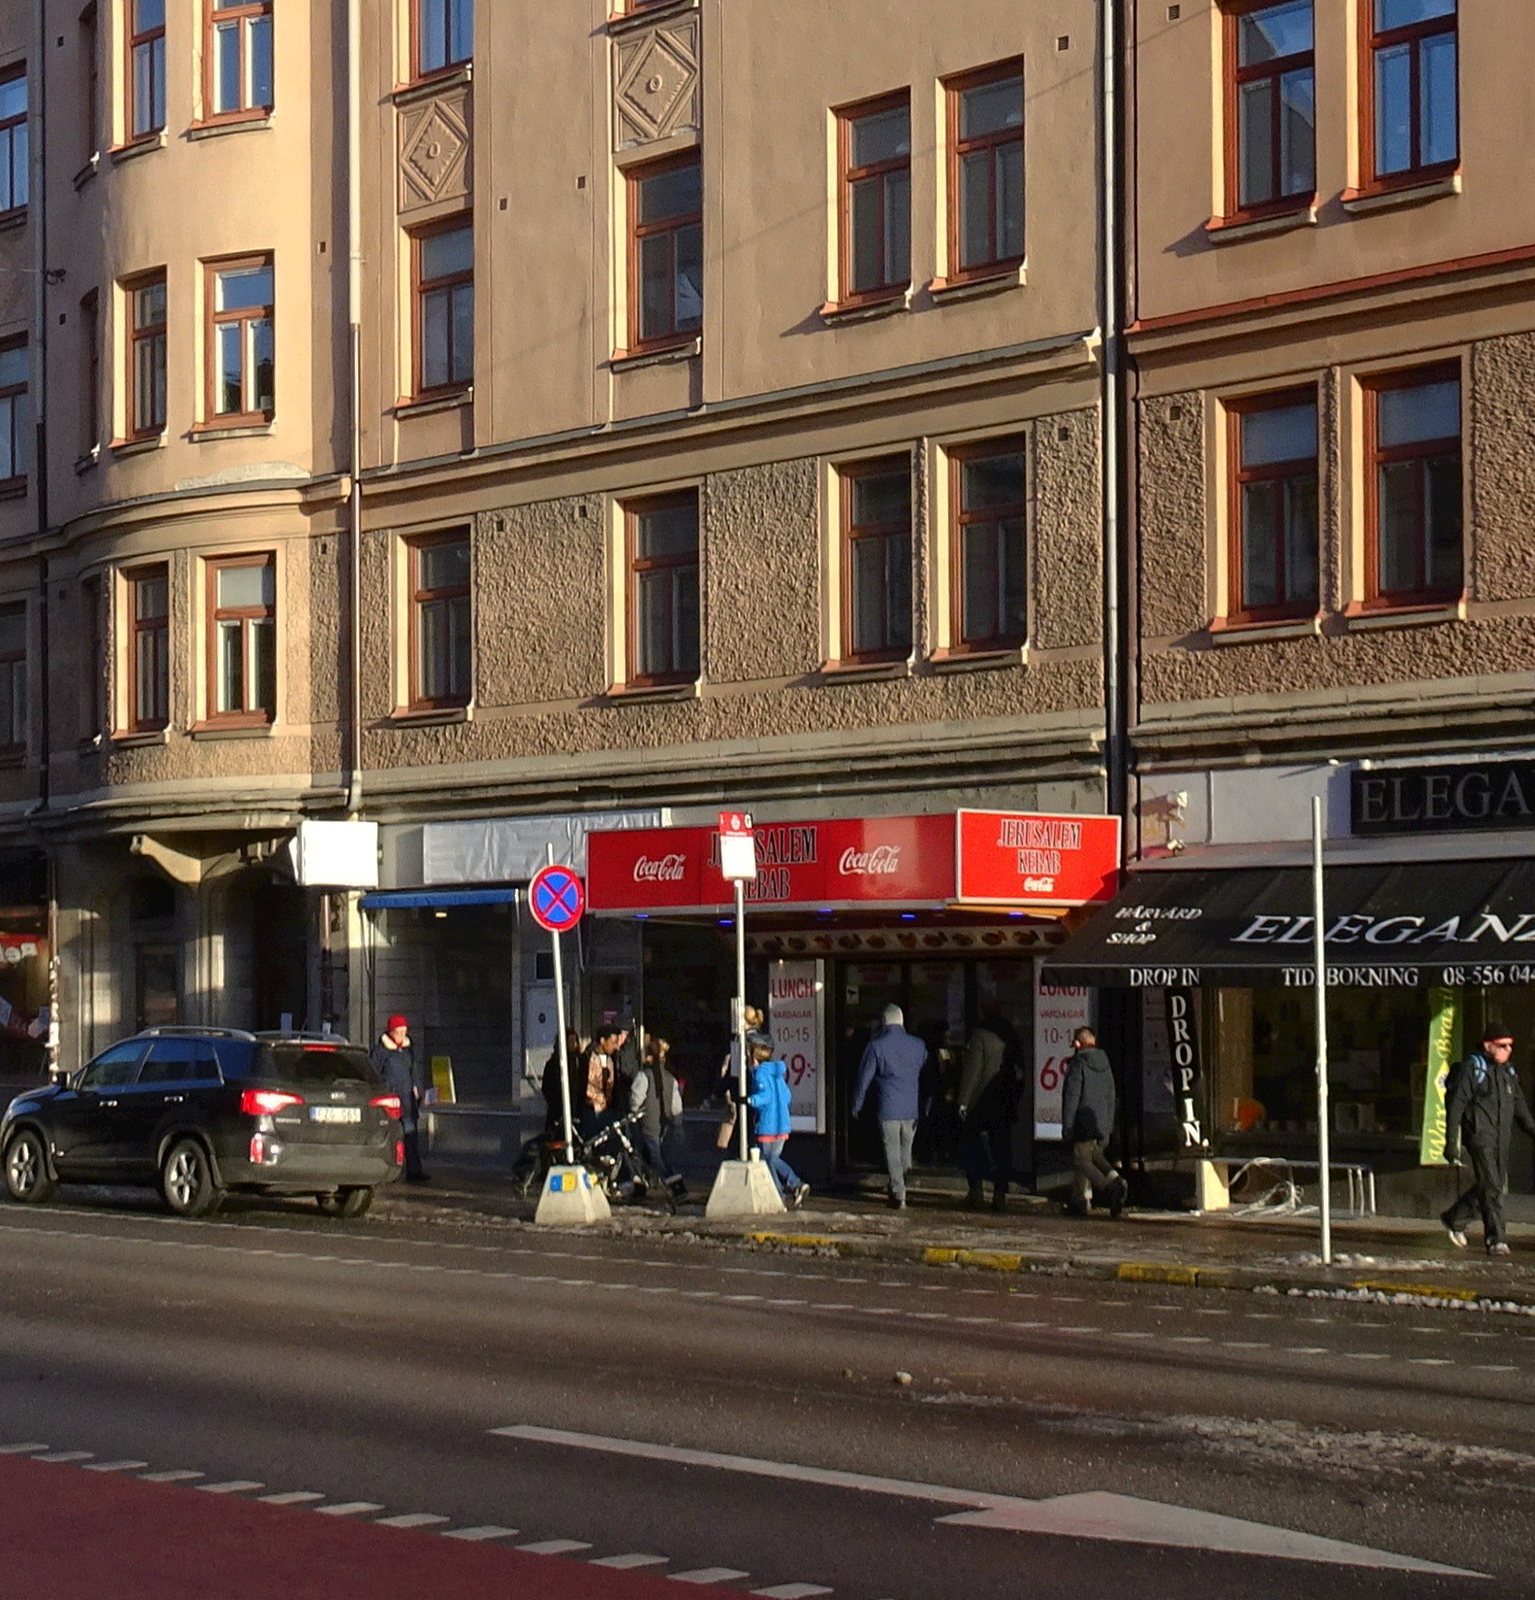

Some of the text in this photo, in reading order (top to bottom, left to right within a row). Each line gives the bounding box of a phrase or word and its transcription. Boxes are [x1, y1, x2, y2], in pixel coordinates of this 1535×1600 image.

[997, 819, 1082, 850] JERUSALEM
[707, 827, 817, 867] JSALEM
[1018, 849, 1061, 875] KEBAB
[736, 869, 791, 900] EBAB
[1106, 932, 1157, 945] SHOP
[1129, 967, 1201, 987] DROP IN
[1443, 965, 1506, 986] 08-556
[771, 978, 814, 999] LUNCH
[777, 1027, 810, 1042] 10-15
[1044, 1027, 1075, 1044] 10-1
[1171, 994, 1194, 1092] DROP
